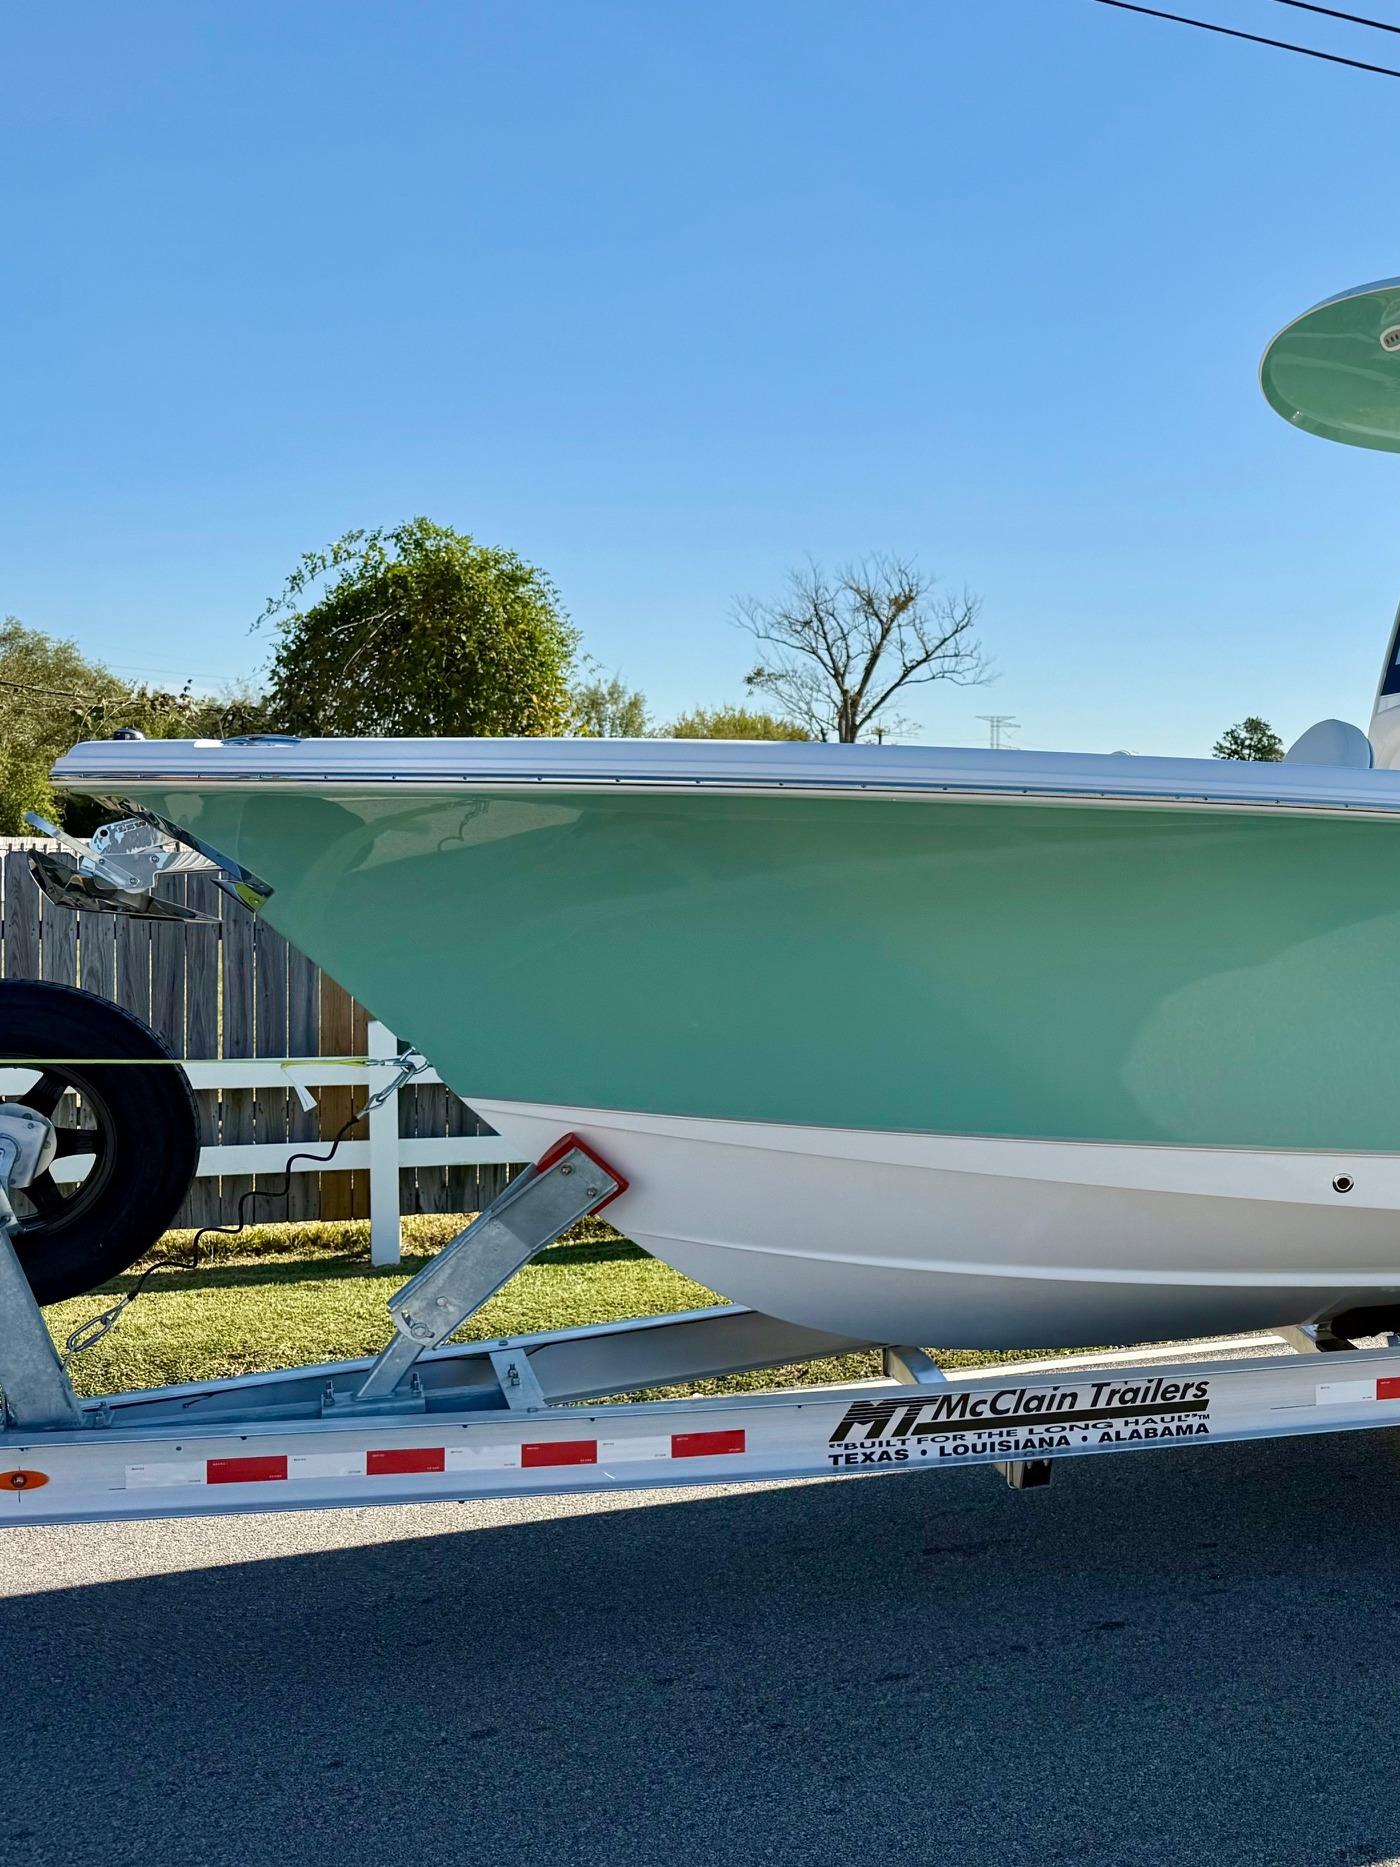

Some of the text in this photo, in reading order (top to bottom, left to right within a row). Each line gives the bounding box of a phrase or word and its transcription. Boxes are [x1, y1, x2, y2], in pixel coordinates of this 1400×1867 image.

[829, 1395, 941, 1442] MT
[931, 1377, 1210, 1421] McClain Trailers
[828, 1422, 1210, 1467] TEXAS LOUISIANA ALABAMA
[917, 1433, 966, 1445] FOR
[973, 1429, 1018, 1440] THE
[1028, 1421, 1114, 1436] LONG
